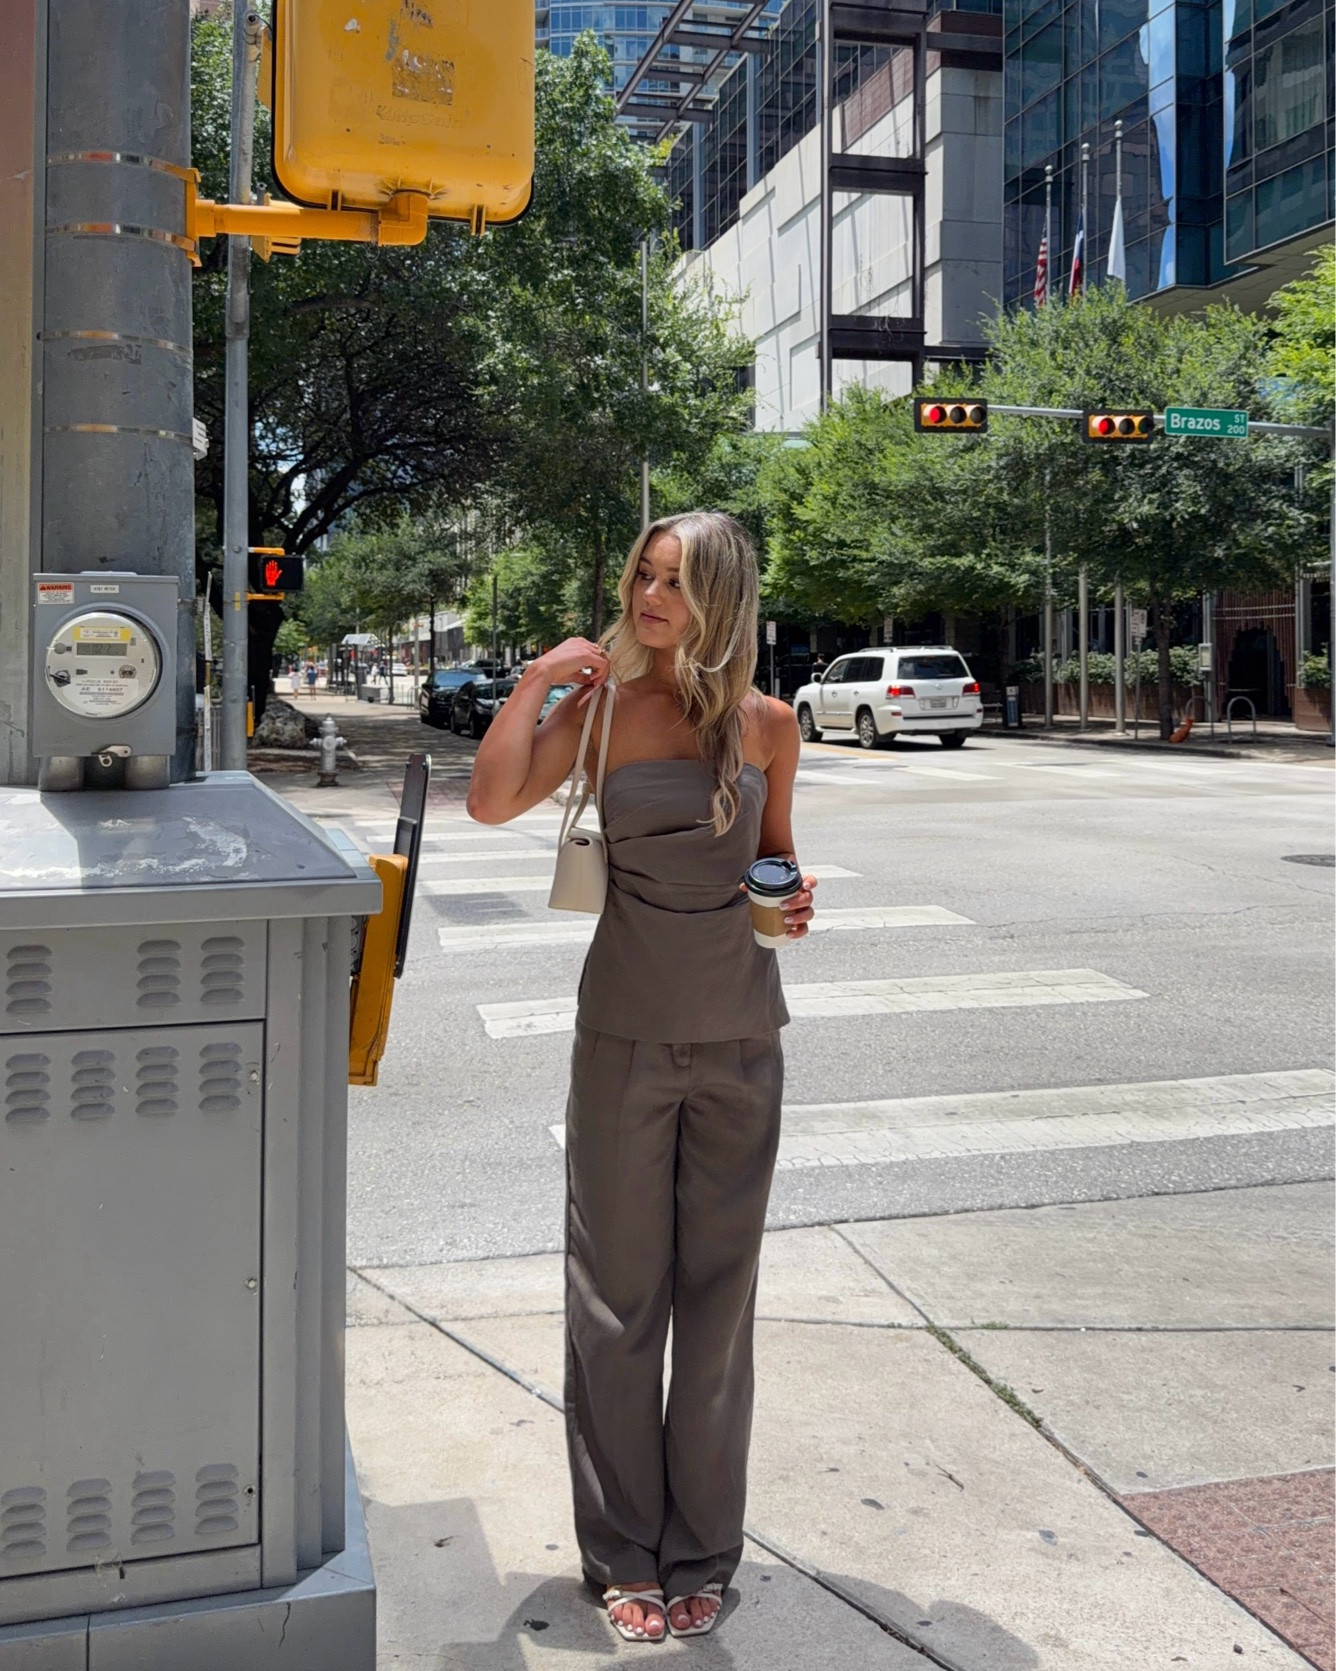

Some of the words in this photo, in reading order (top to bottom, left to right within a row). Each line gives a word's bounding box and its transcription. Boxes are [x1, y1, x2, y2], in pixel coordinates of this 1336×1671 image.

[1171, 413, 1221, 430] Brazos
[1234, 414, 1245, 423] ST
[1227, 425, 1245, 434] 200
